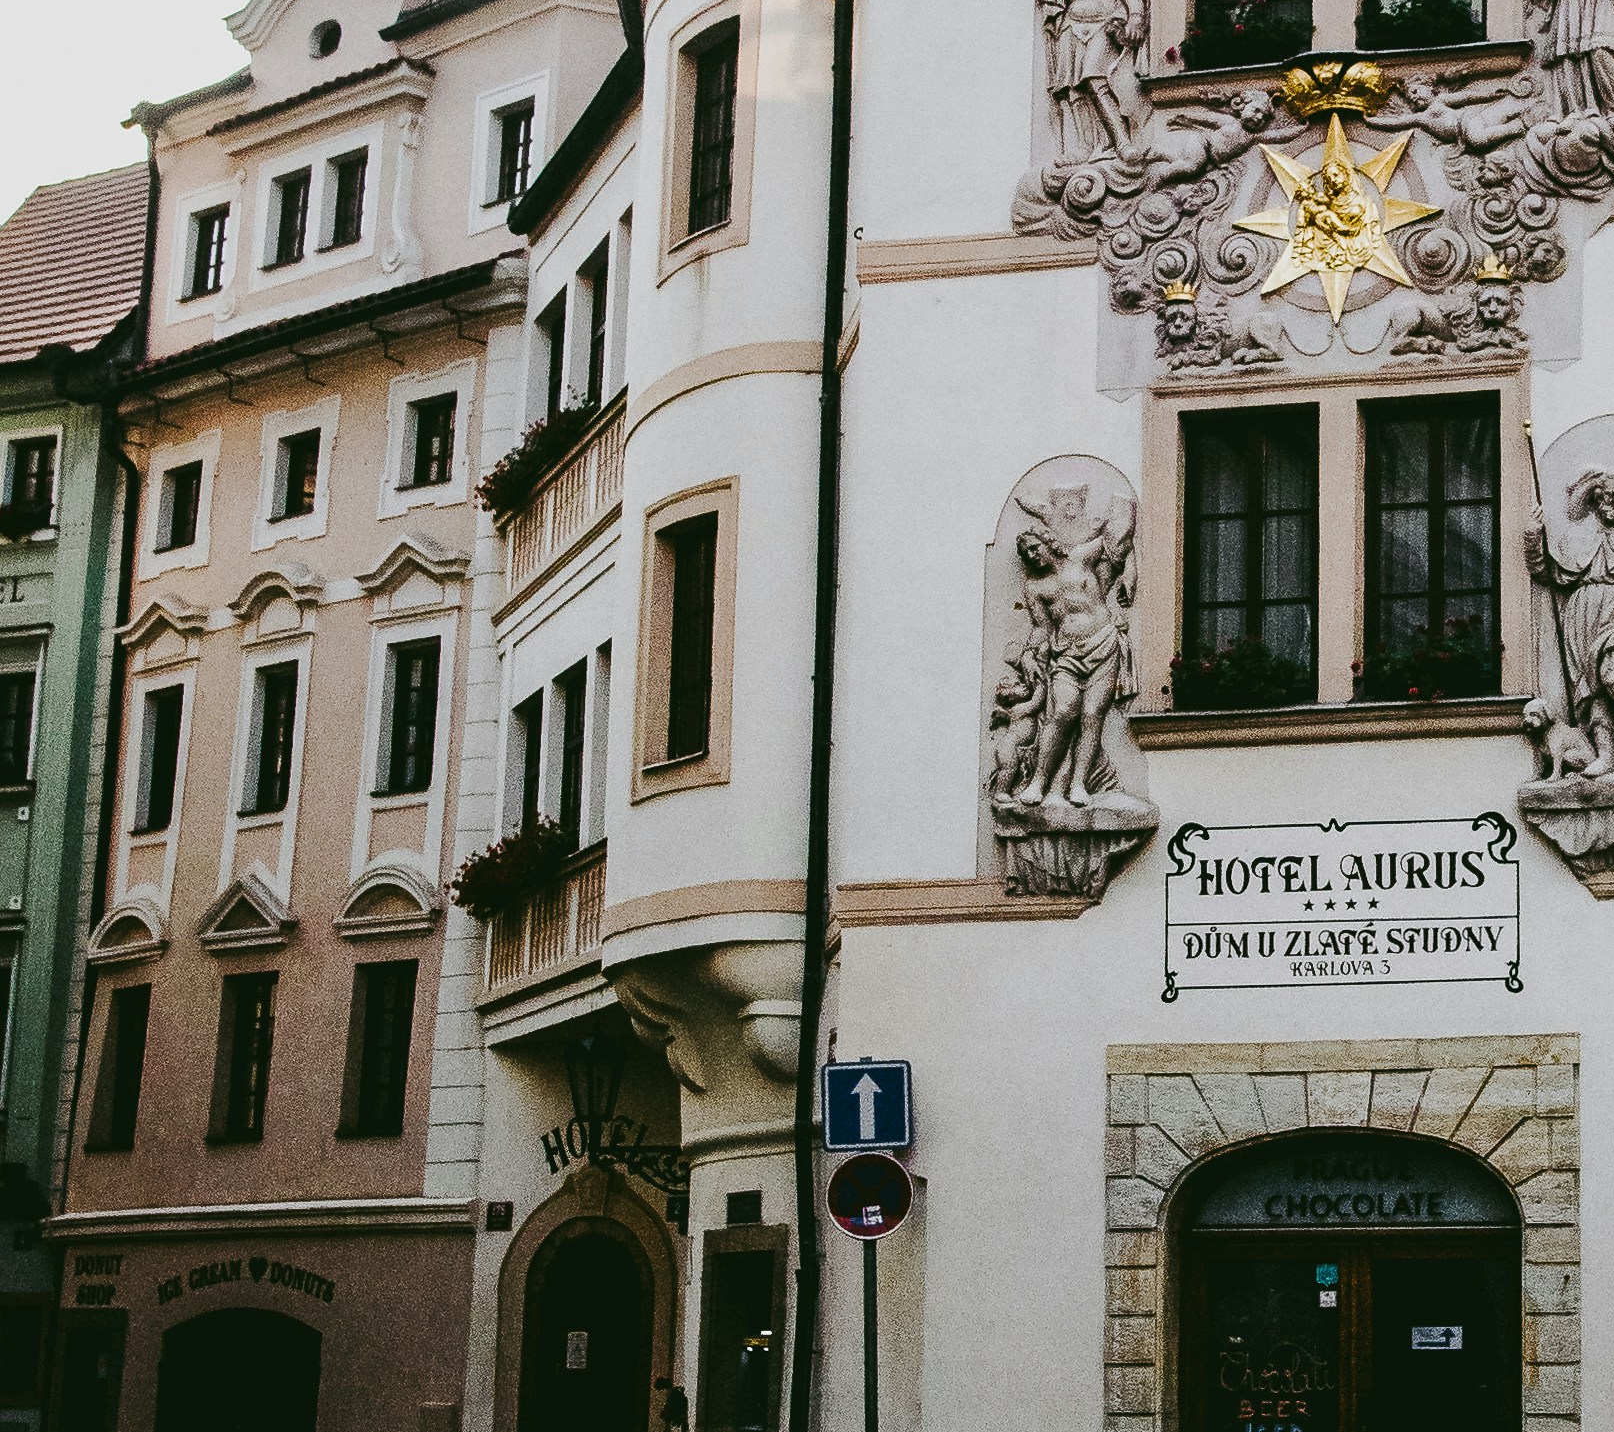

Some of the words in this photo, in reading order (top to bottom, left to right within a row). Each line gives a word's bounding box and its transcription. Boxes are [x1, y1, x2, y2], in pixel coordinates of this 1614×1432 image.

[1196, 852, 1333, 896] HOTEL
[1339, 850, 1485, 891] AURUS
[1183, 927, 1249, 959] DŮM
[1258, 930, 1275, 956] U
[1284, 922, 1378, 957] ZLATÉ
[1386, 926, 1504, 954] STUDNY
[1290, 960, 1374, 977] KARLOVA
[1380, 960, 1391, 974] 3
[1264, 1194, 1443, 1219] CHOCOLATE
[76, 1284, 116, 1305] SHOP
[157, 1275, 183, 1305] ICE
[188, 1259, 241, 1290] CREAM
[269, 1262, 336, 1303] DONUTS
[1238, 1398, 1311, 1418] BEER
